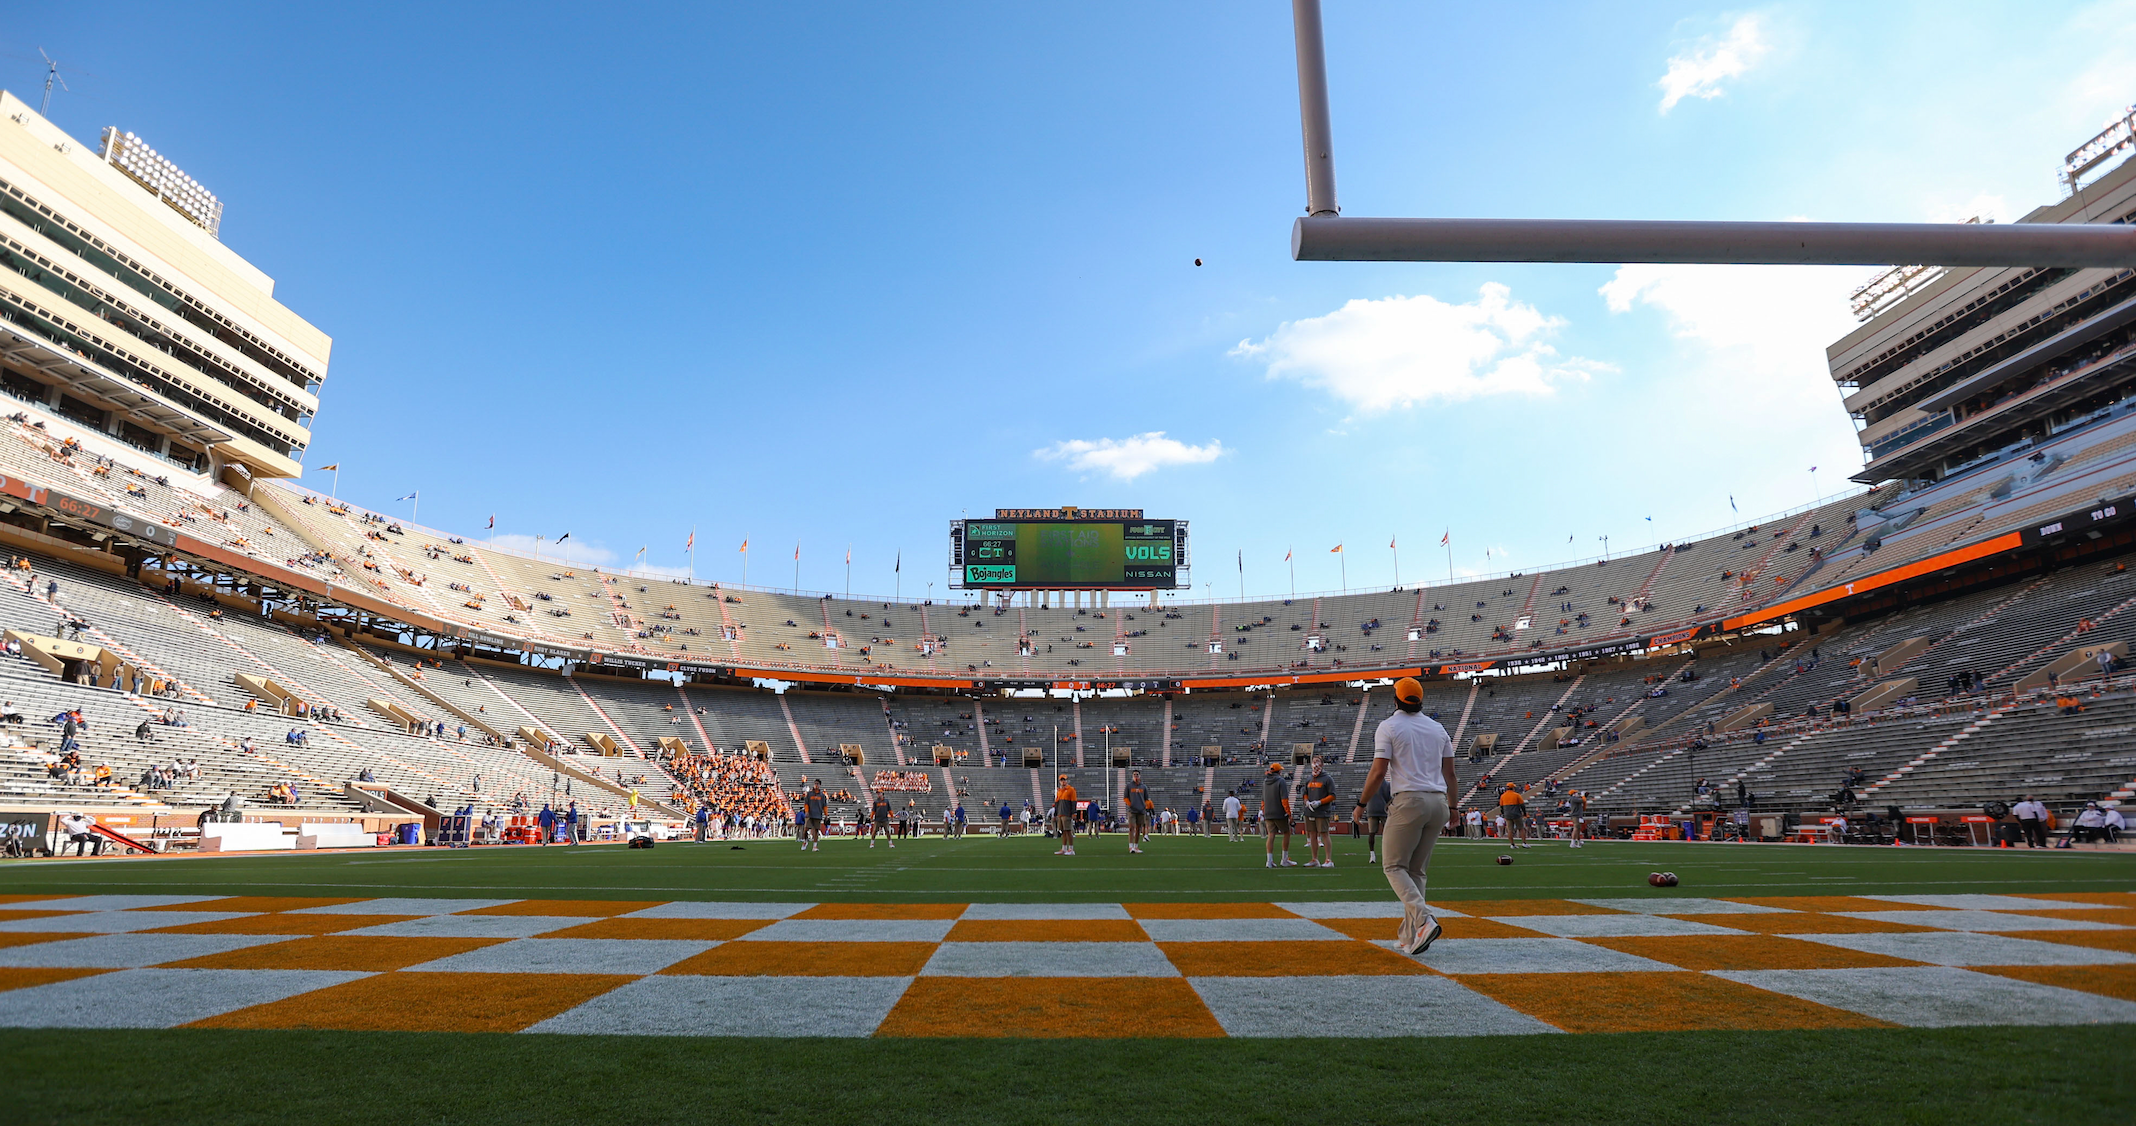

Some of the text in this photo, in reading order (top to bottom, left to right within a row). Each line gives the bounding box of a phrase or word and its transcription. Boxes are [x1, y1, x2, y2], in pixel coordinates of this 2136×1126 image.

[59, 497, 100, 519] 66:27
[1000, 506, 1139, 520] NEYLAND T STADIUM
[146, 526, 155, 537] 0
[1125, 546, 1170, 560] VOLS
[970, 567, 1013, 580] Bojangles
[1654, 631, 1691, 645] CHAMPIONS
[1448, 664, 1482, 672] NATIONAL
